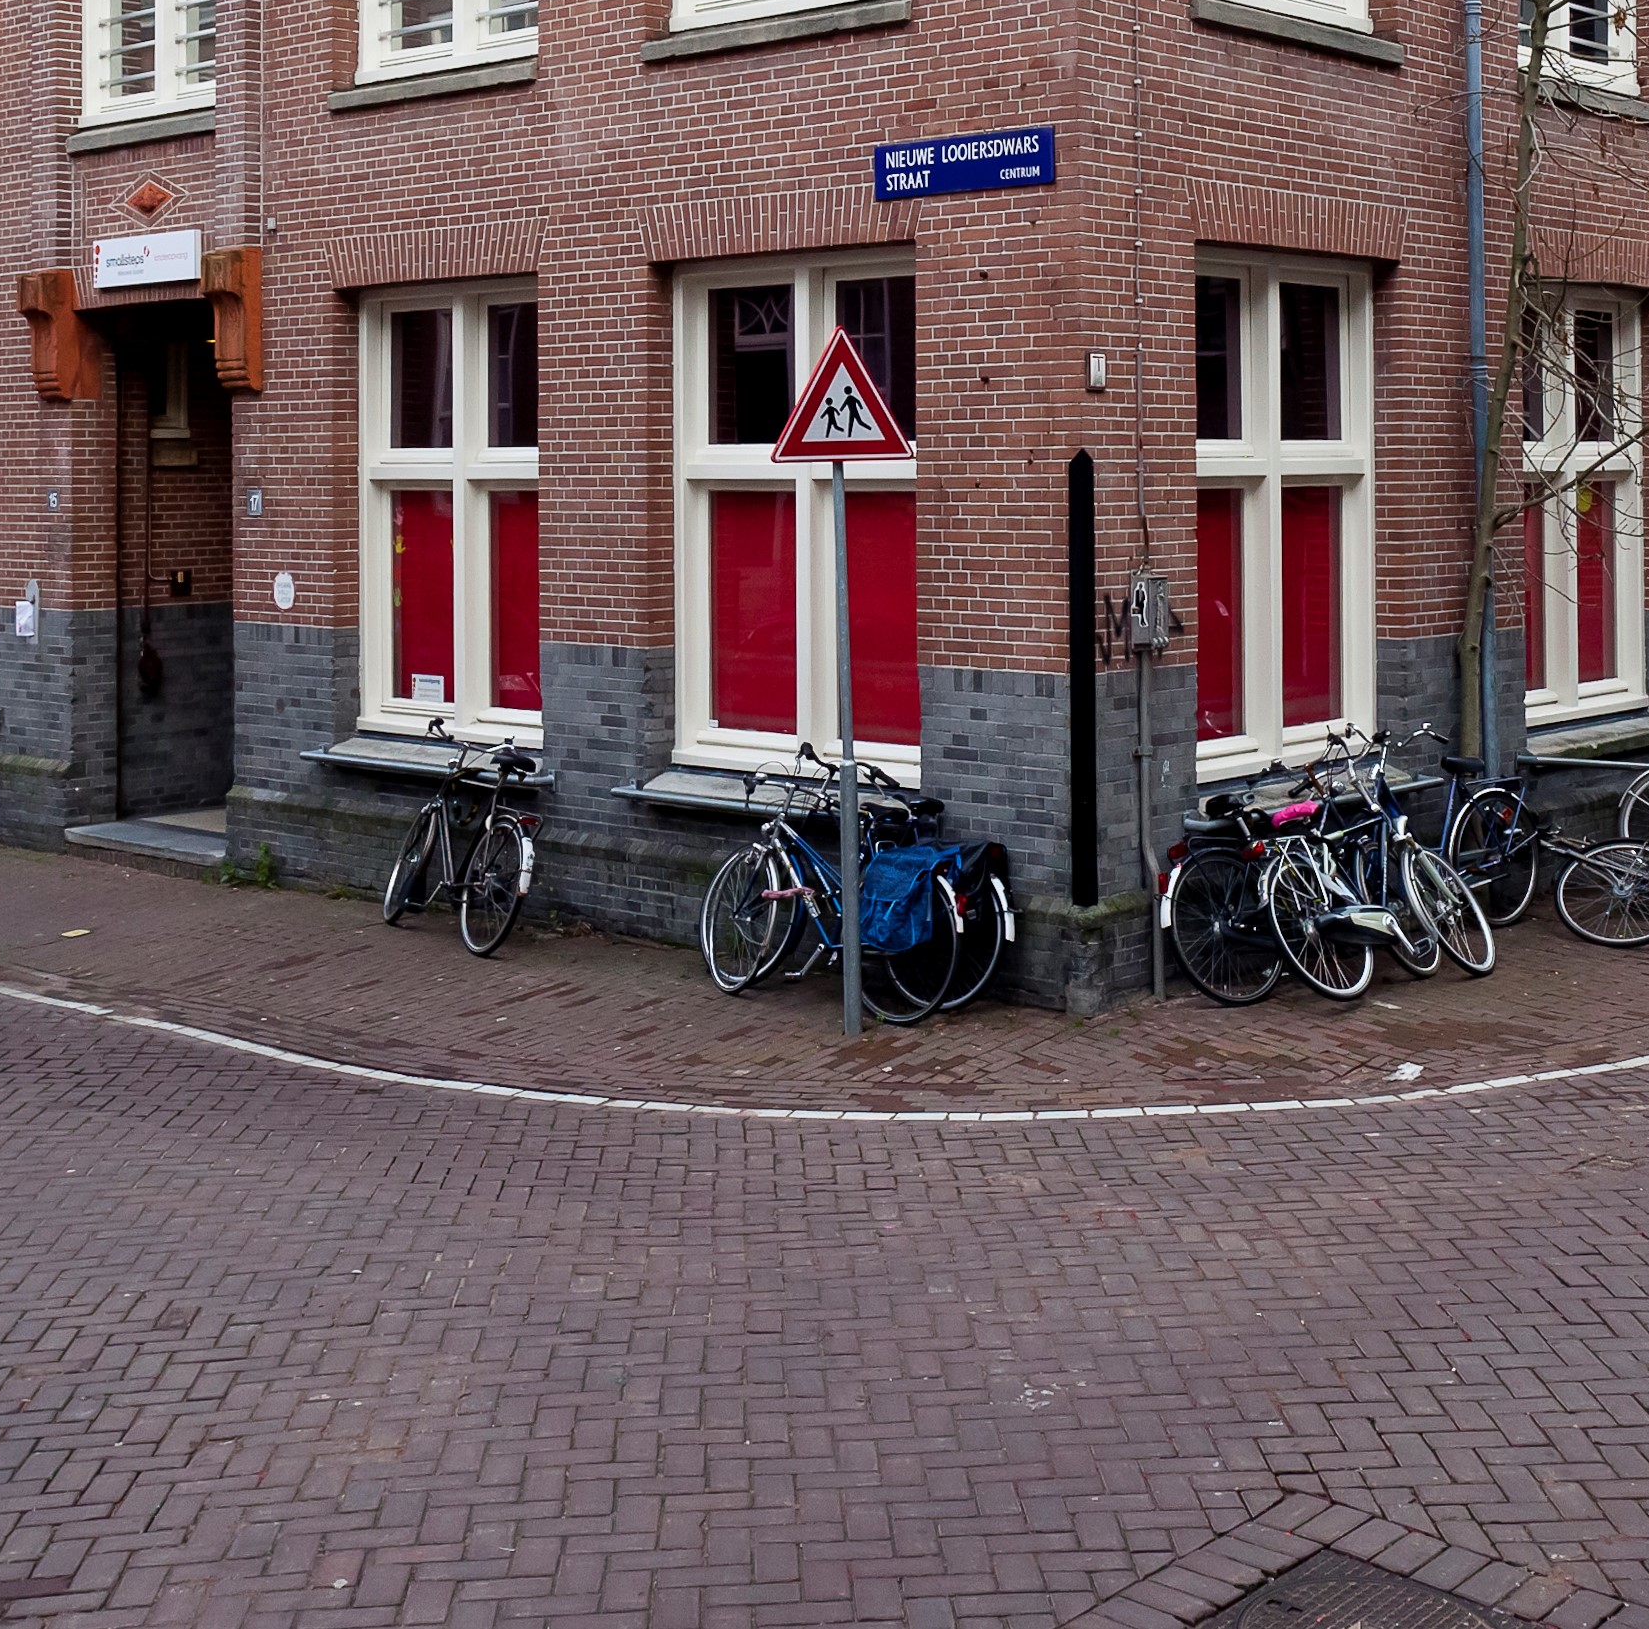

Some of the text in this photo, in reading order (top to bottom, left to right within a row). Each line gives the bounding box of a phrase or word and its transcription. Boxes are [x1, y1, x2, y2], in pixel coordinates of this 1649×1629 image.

[885, 135, 1040, 169] NIEUWE LOOIERSDWARS
[885, 170, 931, 192] STRAAT
[999, 165, 1040, 180] CENTRUM
[105, 252, 145, 269] smallsteps
[249, 494, 260, 511] 17
